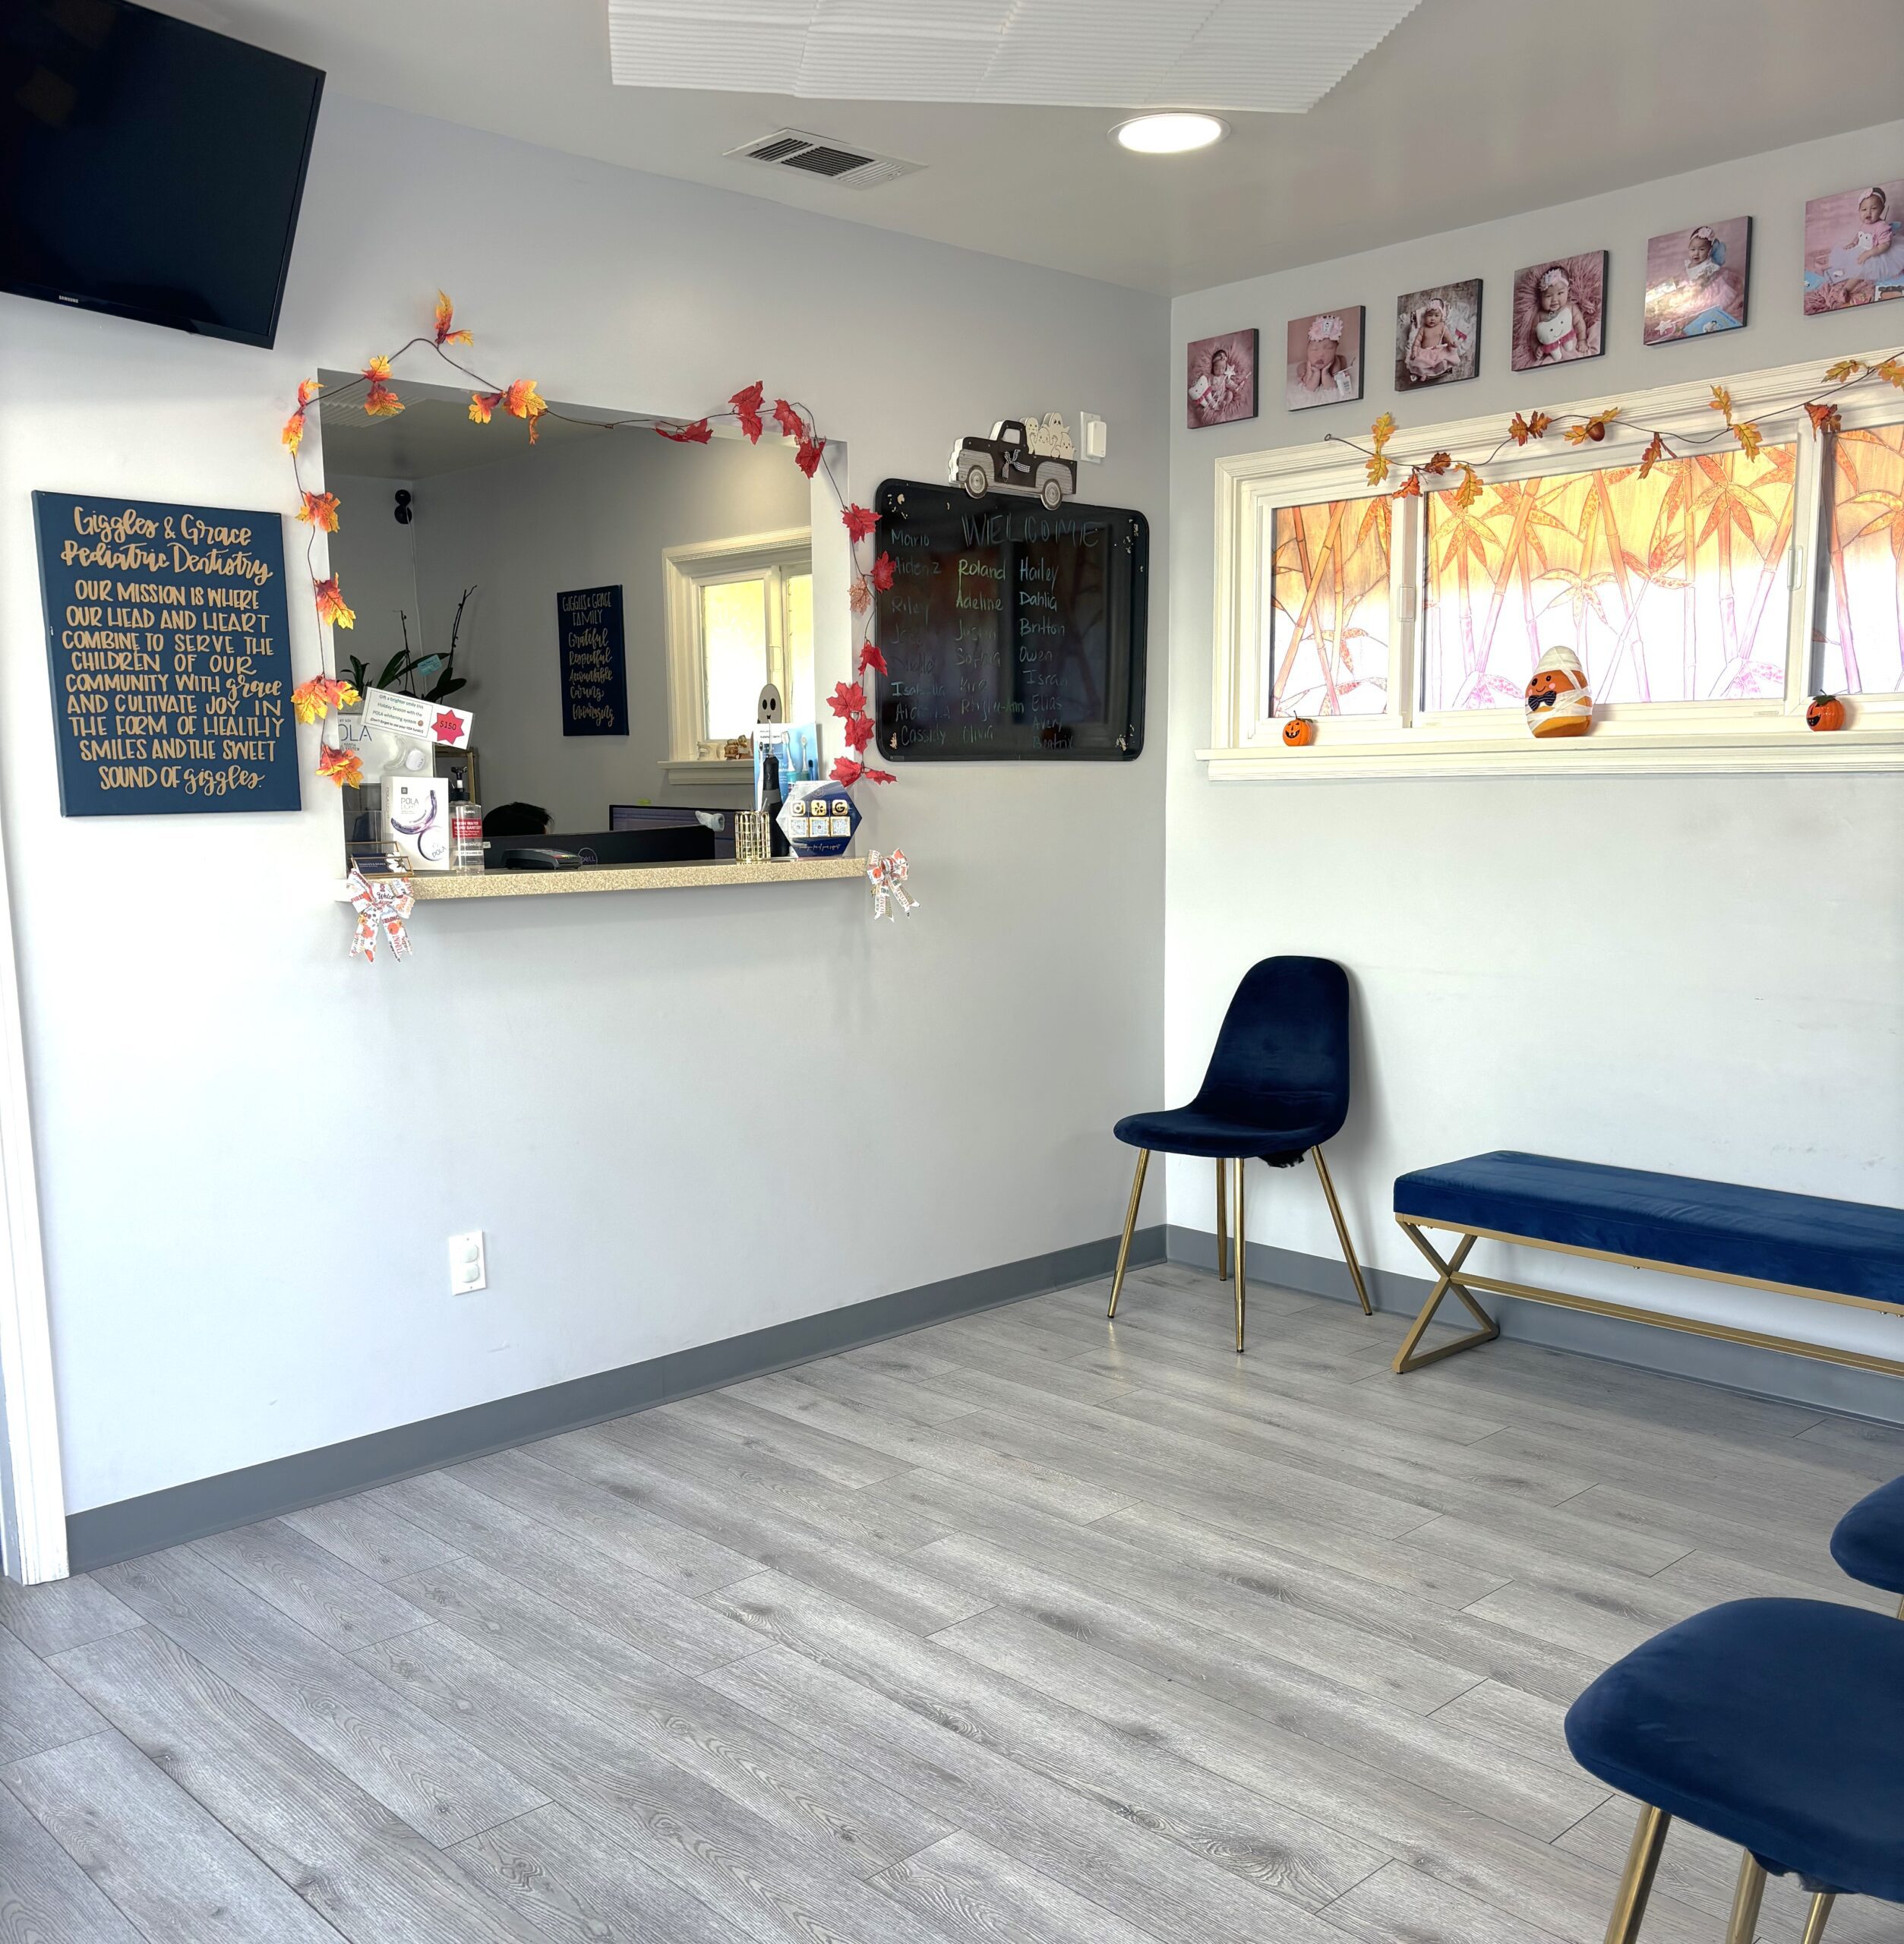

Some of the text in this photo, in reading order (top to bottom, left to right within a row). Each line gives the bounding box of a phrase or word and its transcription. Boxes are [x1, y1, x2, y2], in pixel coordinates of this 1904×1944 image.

[74, 507, 251, 546] Giggles & Grace
[961, 512, 1105, 548] WELCOME
[891, 528, 930, 548] Mario
[61, 541, 273, 586] Pediatric Dentistry
[958, 558, 1006, 583] Roland
[1020, 557, 1059, 589] Hailey
[75, 580, 259, 610] OUR MISSION IS WHERE
[562, 594, 587, 612] GIGGLES
[592, 592, 611, 608] GRACE
[955, 590, 1003, 611] Adeline
[1019, 592, 1057, 612] Dahlia
[66, 606, 270, 633] OUR HEAD AND HEART
[573, 610, 603, 626] FAMILY
[1020, 618, 1065, 637] Britton
[62, 631, 274, 656] COMBINE TO SERVE THE
[569, 627, 608, 649] Grateful
[71, 652, 257, 675] CHILDREN OF OUR
[570, 647, 613, 668] Respectful
[1020, 647, 1053, 662] Owen
[569, 667, 613, 685] Accountable
[65, 674, 282, 700] COMMUNITY WITH grace
[570, 685, 604, 702] Caring
[67, 695, 281, 716] AND CULTIVATE JOY IN
[1031, 694, 1063, 712] Elias
[68, 715, 284, 737] THE FORM OF HEALTHY
[384, 712, 403, 721] whitening
[440, 720, 456, 731] $150
[1033, 716, 1063, 733] Avery
[901, 723, 946, 746] Cassidy
[80, 738, 276, 762] SMILES AND THE SWEET
[98, 765, 265, 796] SOUND OF giggles.
